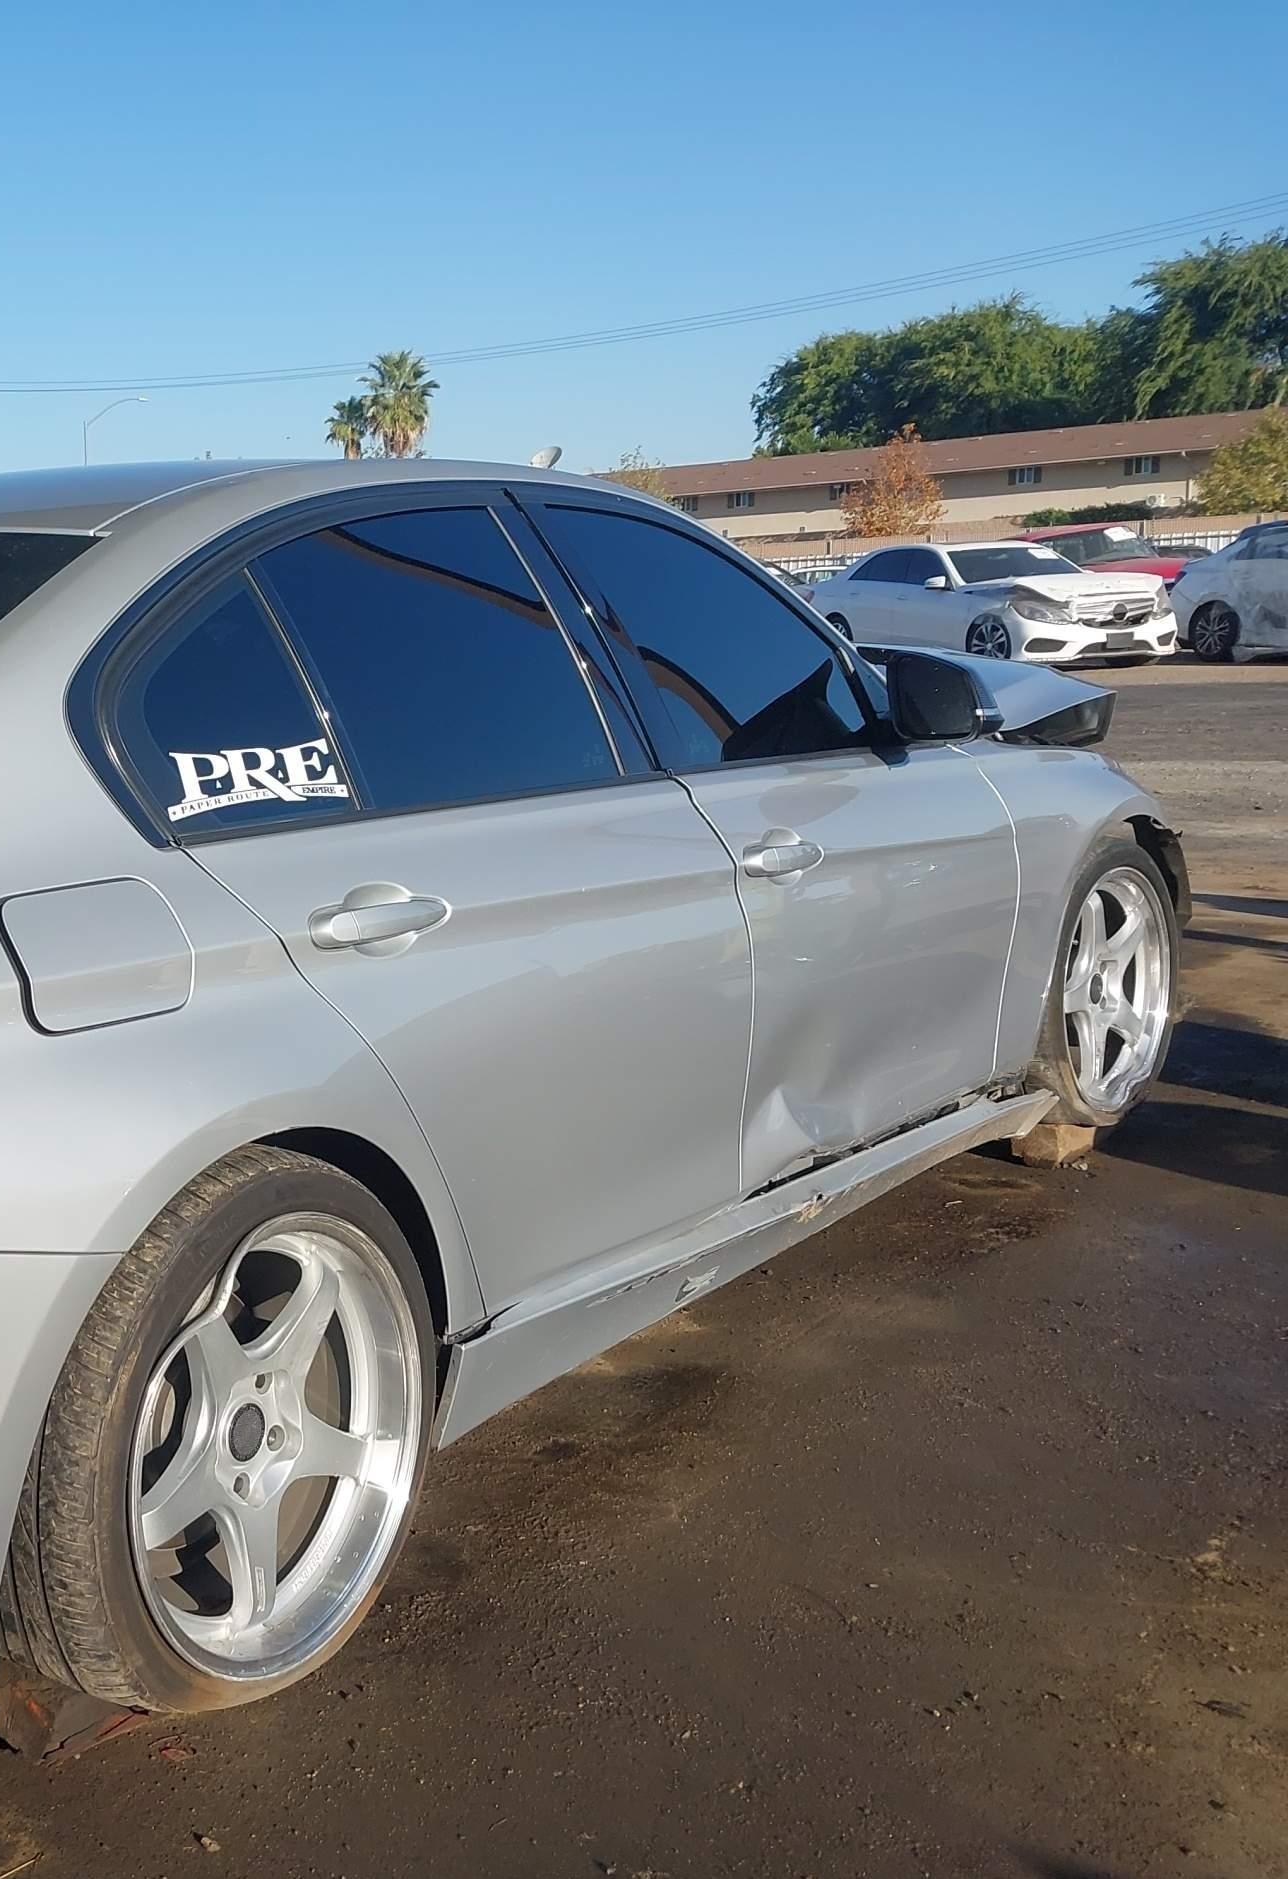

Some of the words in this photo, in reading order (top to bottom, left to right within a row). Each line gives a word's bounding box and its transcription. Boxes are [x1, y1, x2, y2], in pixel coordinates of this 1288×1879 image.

[169, 738, 338, 801] PRE
[181, 797, 221, 814] PAPER
[227, 791, 269, 803] ROUTE
[302, 787, 336, 795] EMPIRE
